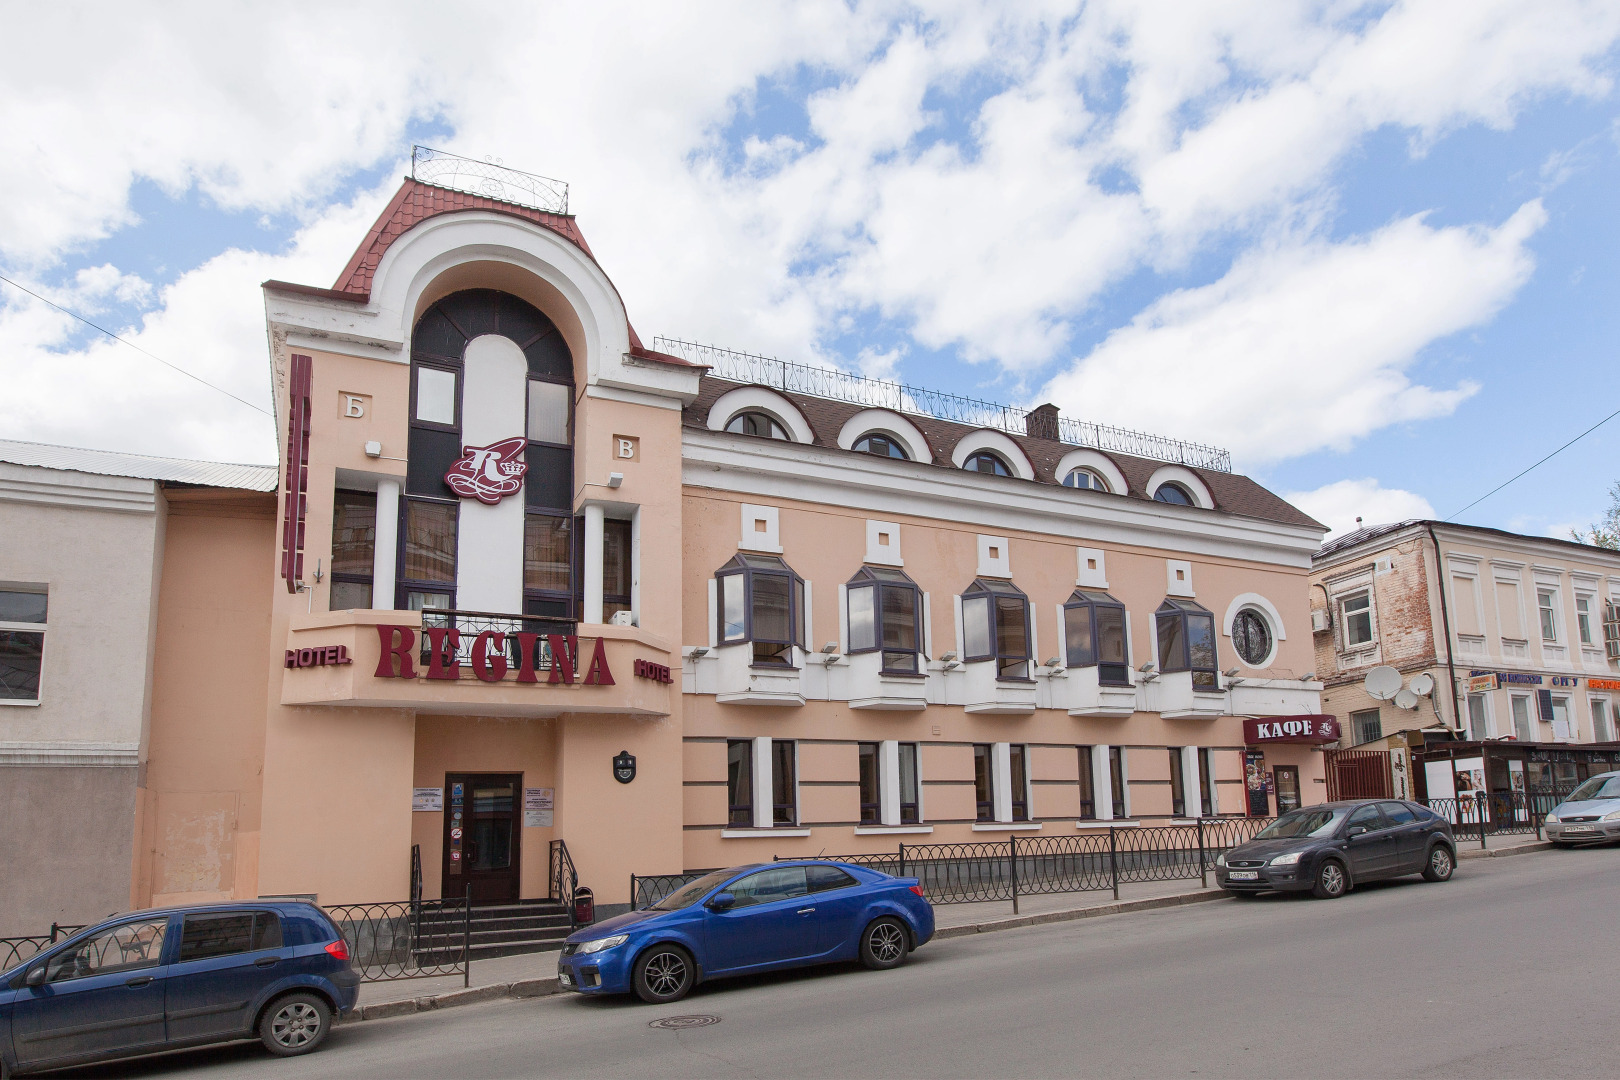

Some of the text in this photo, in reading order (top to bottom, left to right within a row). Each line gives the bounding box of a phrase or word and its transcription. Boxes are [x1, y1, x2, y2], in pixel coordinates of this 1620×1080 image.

[344, 394, 364, 418] Б
[284, 644, 352, 669] HOTEL
[374, 624, 616, 685] REGINA
[634, 658, 674, 684] HOTEL
[1257, 720, 1312, 739] КАФЕ
